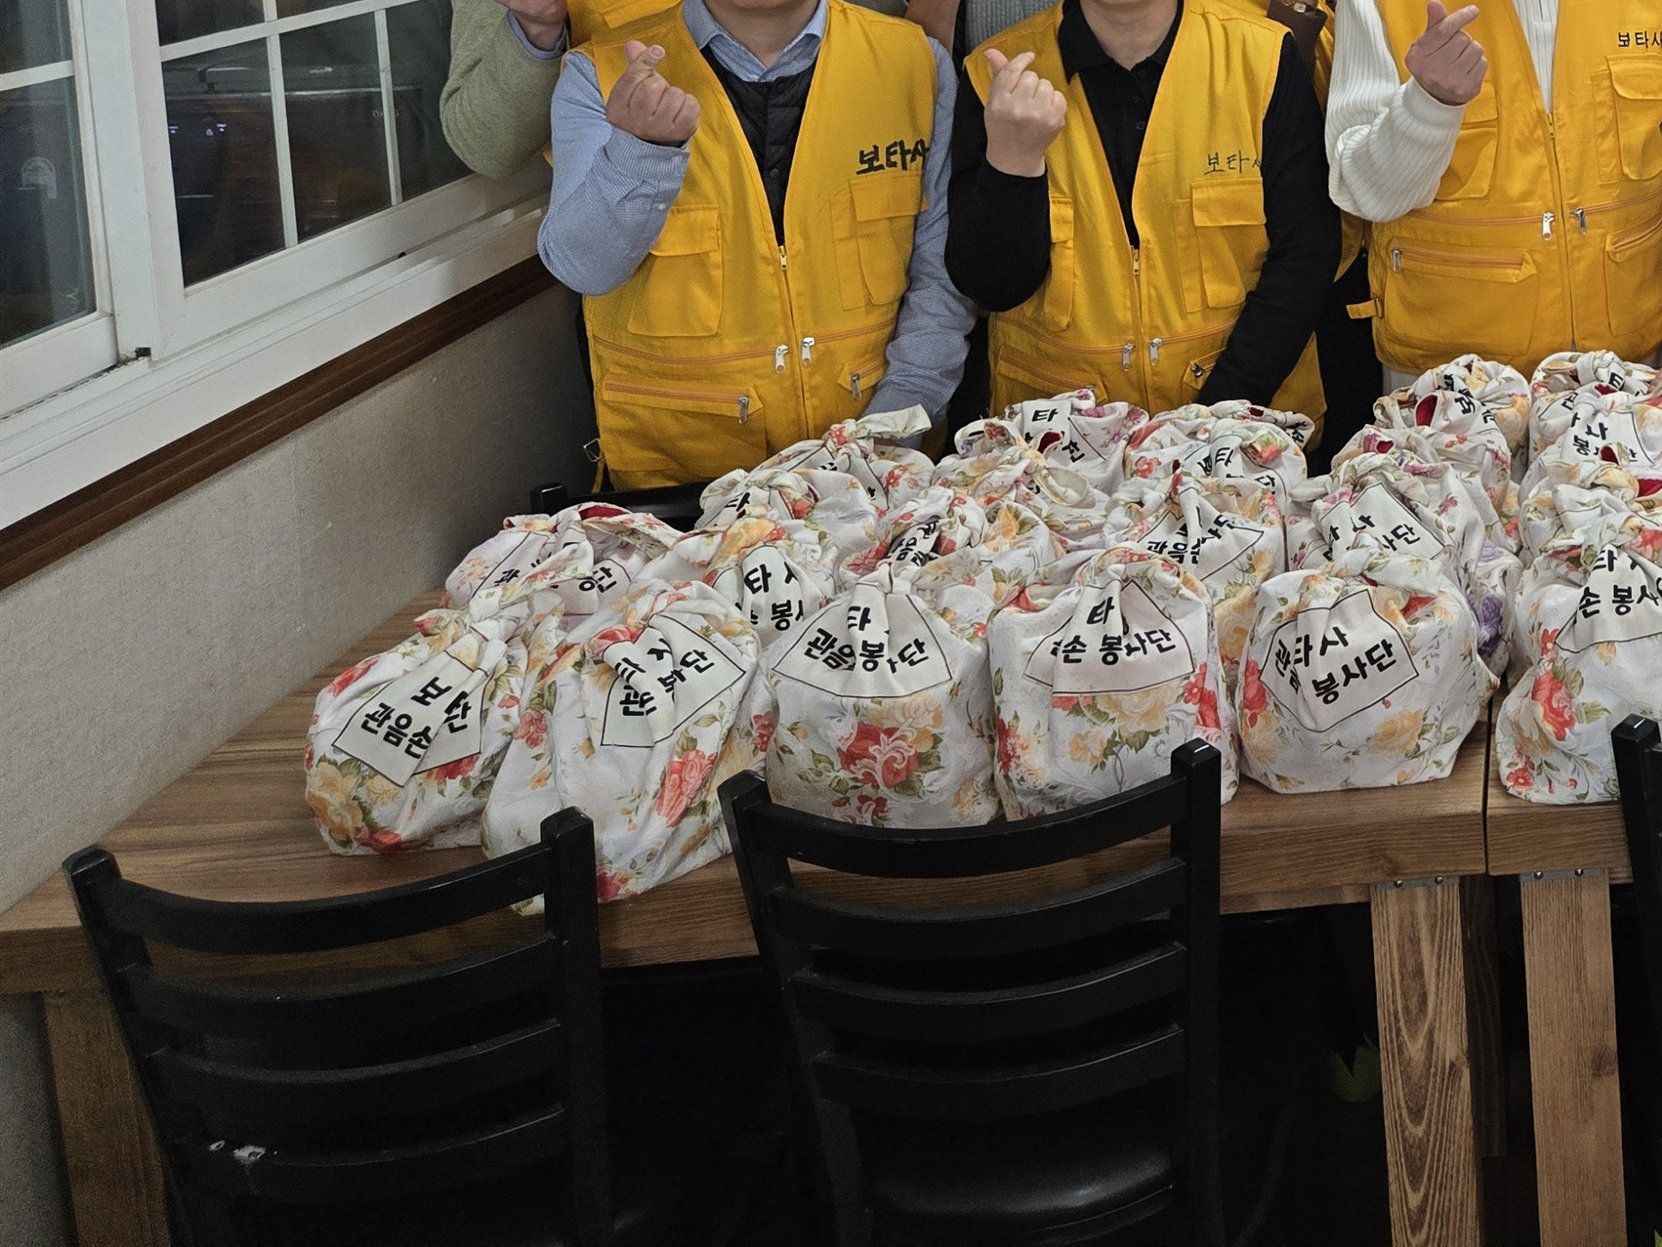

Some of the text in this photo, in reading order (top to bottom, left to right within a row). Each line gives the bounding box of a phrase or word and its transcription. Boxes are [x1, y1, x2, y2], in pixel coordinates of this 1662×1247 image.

[1618, 31, 1662, 49] 보타사
[856, 139, 930, 175] 보타사
[804, 628, 856, 671] 관음
[1293, 626, 1349, 667] 타사
[1312, 639, 1397, 704] 봉사단
[361, 702, 433, 759] 관음손
